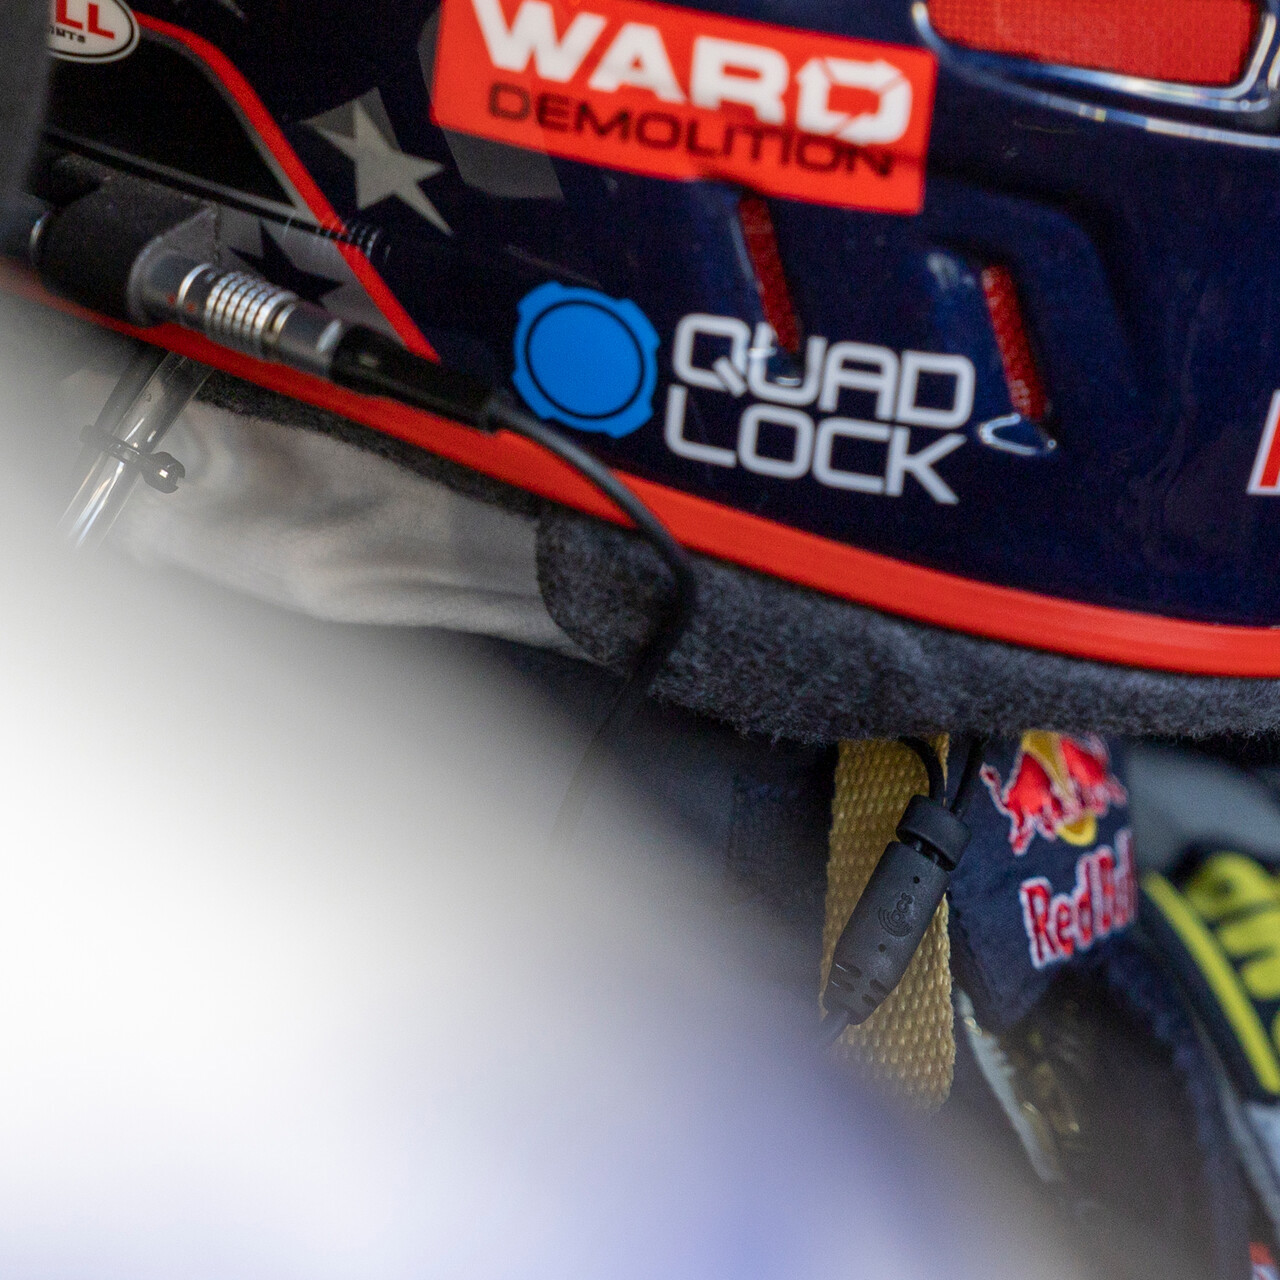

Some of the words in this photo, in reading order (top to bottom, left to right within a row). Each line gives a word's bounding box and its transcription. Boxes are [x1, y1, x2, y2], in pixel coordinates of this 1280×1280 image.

[486, 81, 898, 179] DEMOLITION
[672, 312, 977, 430] QUAD
[664, 383, 968, 505] LOCK
[1020, 853, 1096, 968] Red
